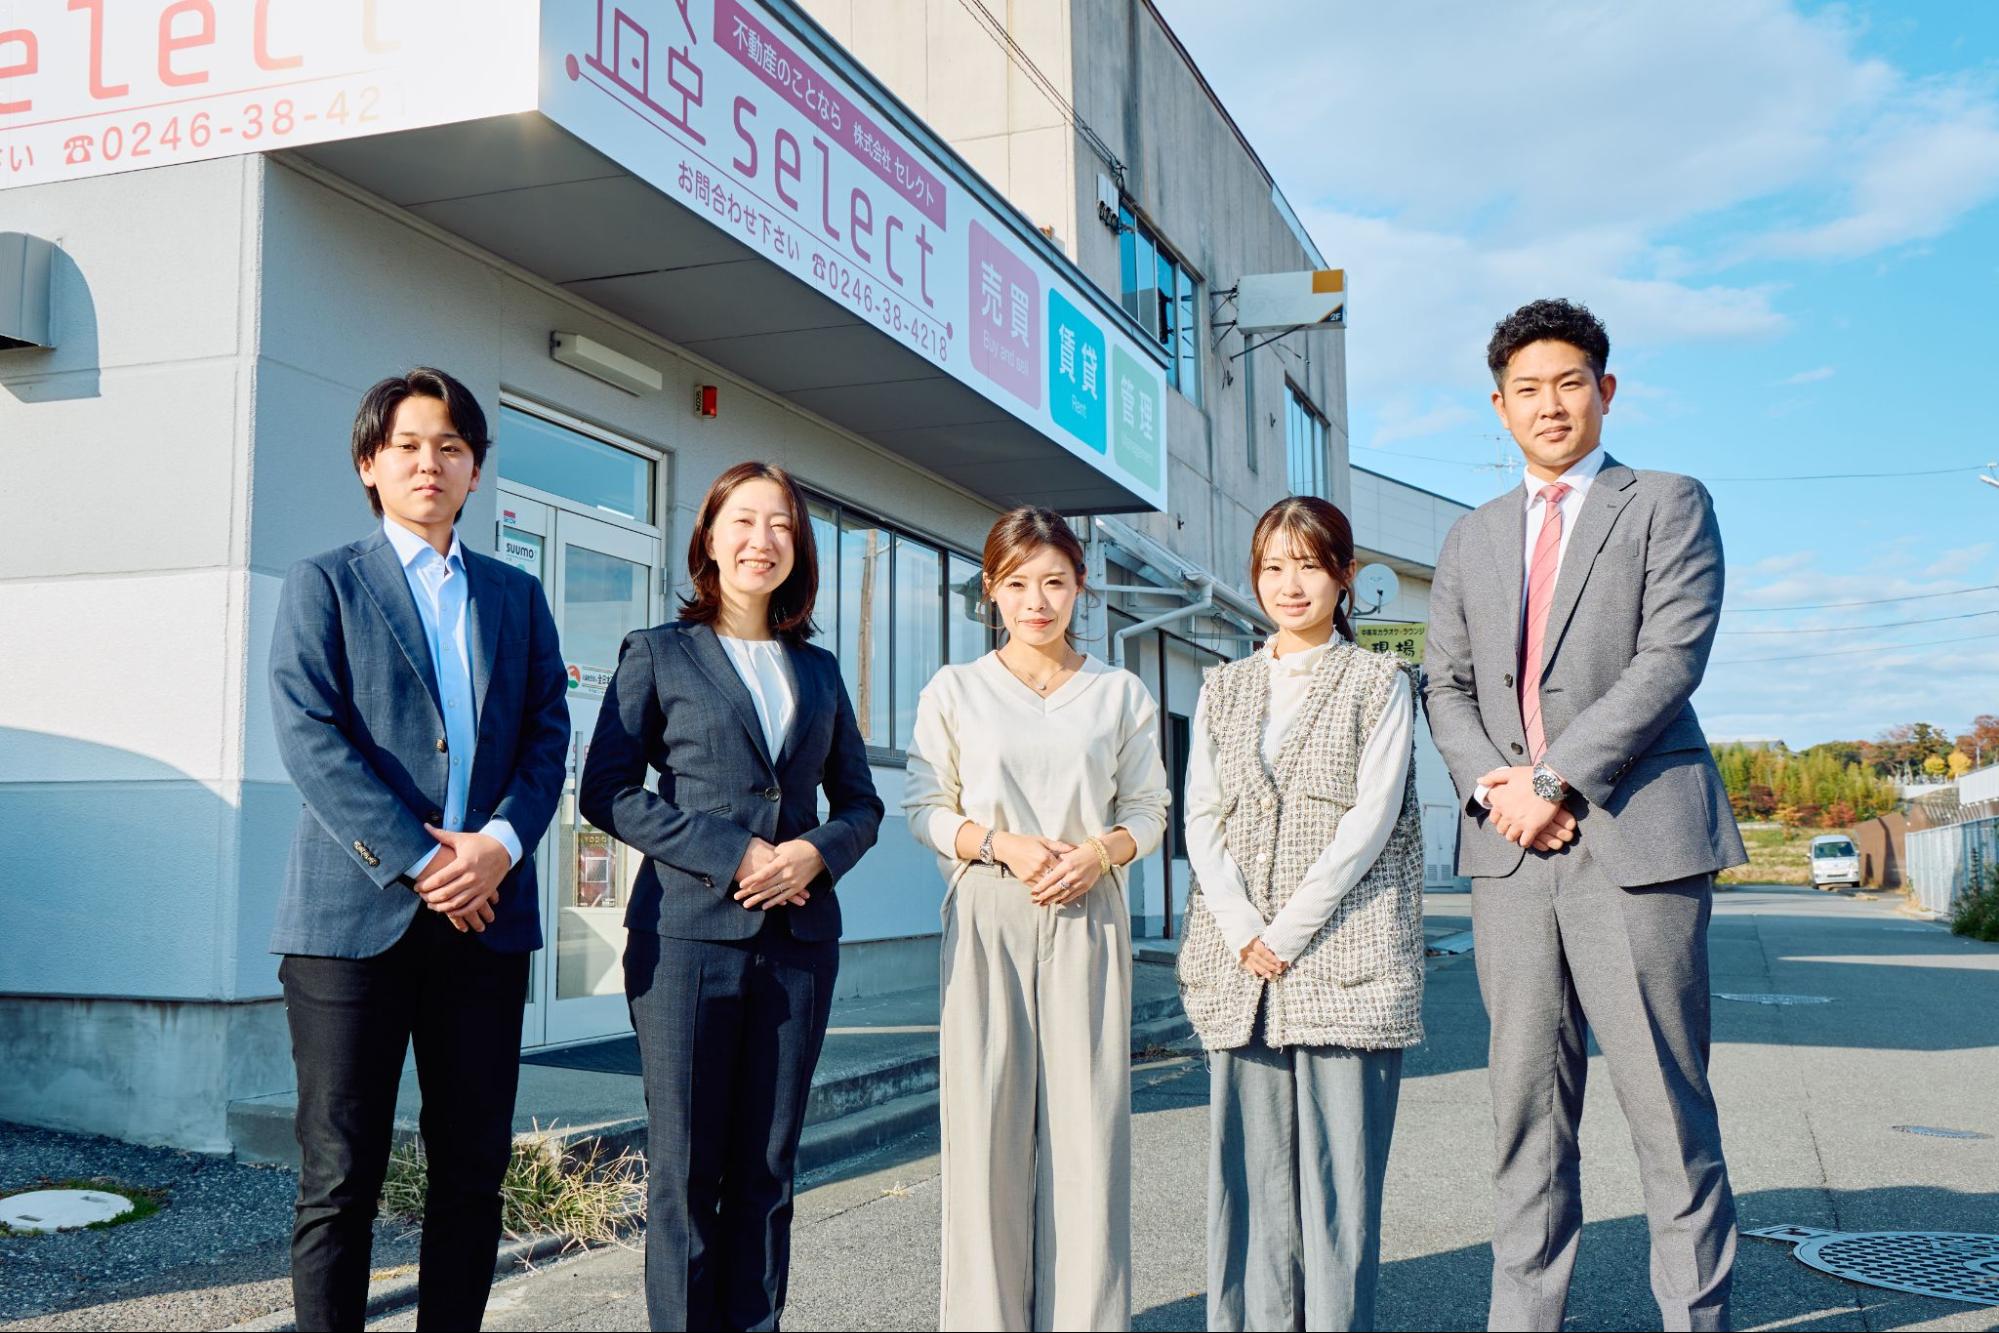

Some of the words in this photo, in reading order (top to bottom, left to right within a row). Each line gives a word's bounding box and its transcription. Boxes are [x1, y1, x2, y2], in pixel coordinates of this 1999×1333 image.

[0, 144, 34, 172] い
[733, 15, 842, 131] 不動産のことなら
[853, 121, 892, 174] 株式会社
[894, 157, 935, 207] セレクト
[677, 160, 801, 261] お問合わせ下さい
[733, 95, 934, 308] select
[829, 260, 948, 363] 0246-38-4218
[981, 260, 1030, 347] 売買
[1330, 312, 1342, 322] 2F
[1058, 324, 1098, 400] 賃貸
